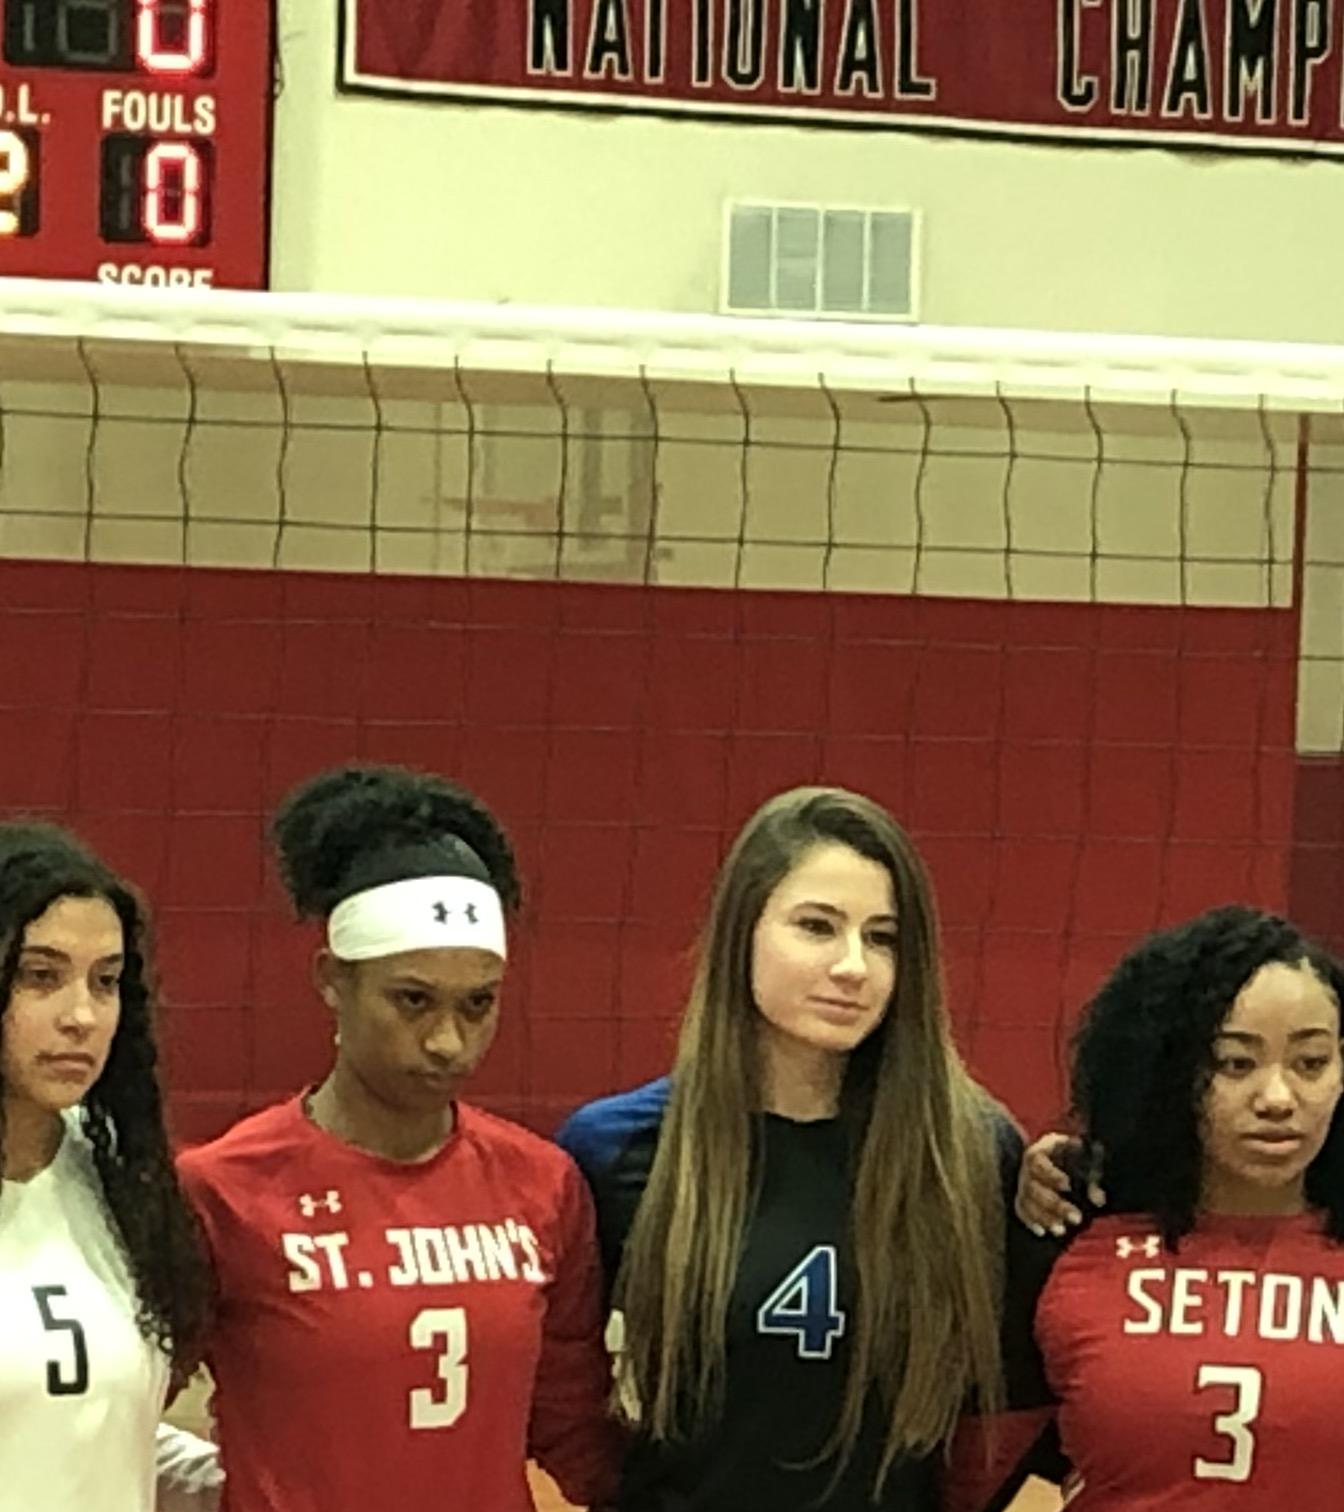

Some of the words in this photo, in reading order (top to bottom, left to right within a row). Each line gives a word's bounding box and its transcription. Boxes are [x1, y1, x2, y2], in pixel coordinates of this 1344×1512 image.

[527, 0, 936, 100] NATIONAL
[102, 89, 216, 135] FOULS
[282, 1231, 374, 1292] ST.
[757, 1245, 846, 1360] 4
[31, 1285, 90, 1397] 5
[408, 1307, 468, 1430] 3
[1193, 1363, 1263, 1482] 3
